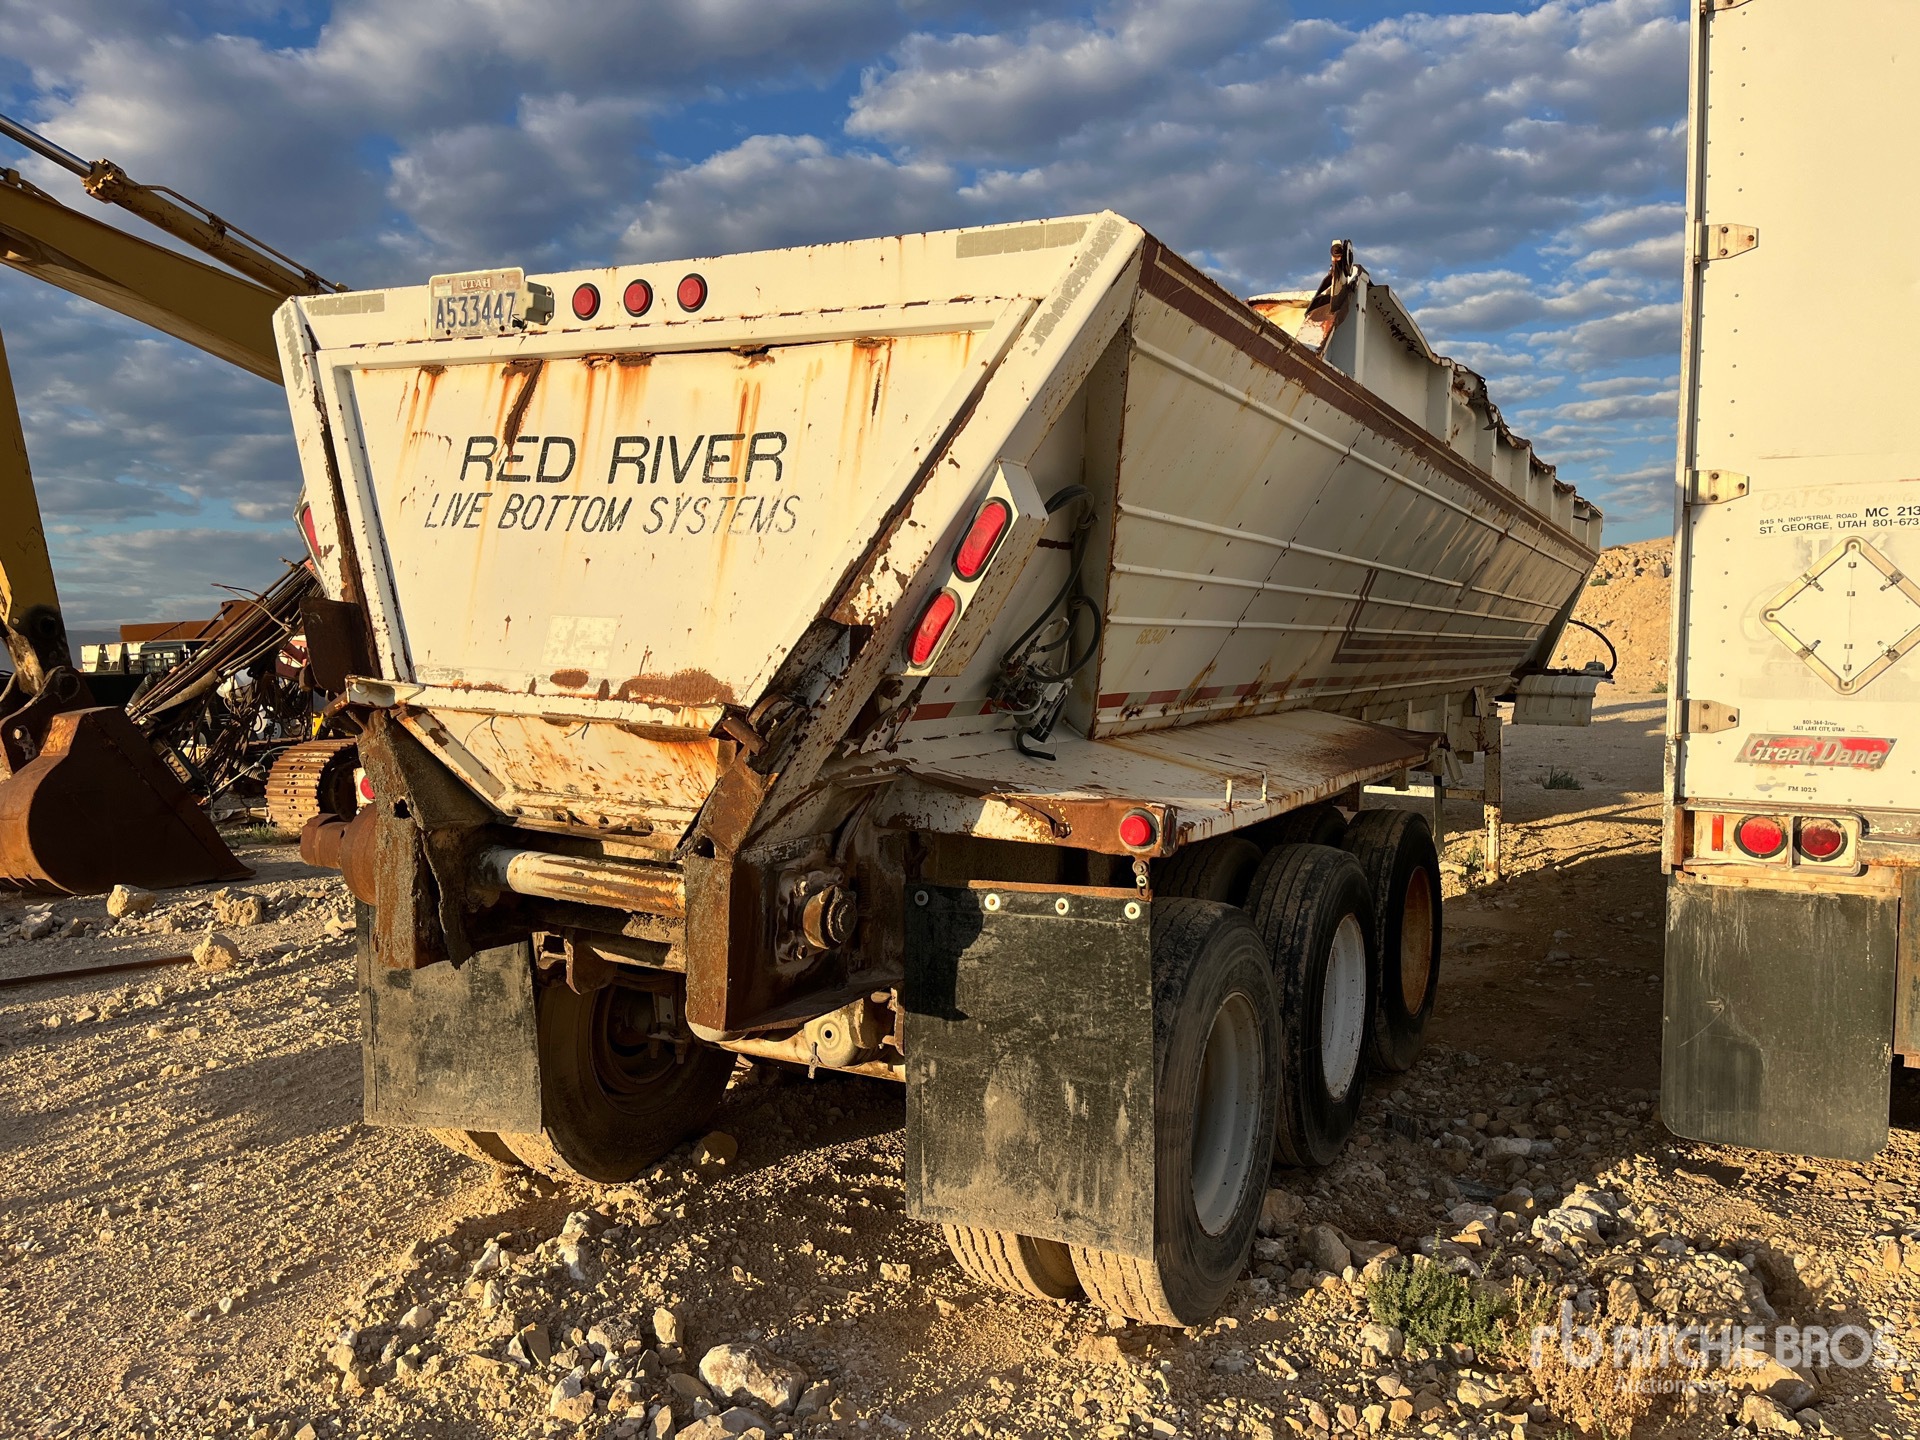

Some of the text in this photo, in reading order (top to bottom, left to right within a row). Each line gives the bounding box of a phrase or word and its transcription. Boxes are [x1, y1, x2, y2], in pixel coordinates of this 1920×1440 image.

[460, 278, 492, 290] UTAH
[436, 291, 516, 329] A533447
[460, 431, 788, 485] RED RIVER
[425, 492, 801, 535] LIVE BOTTOM SYSTEMS
[1760, 517, 1920, 534] ST. GEORGE, UTAH 801-673
[1865, 505, 1920, 518] MC 213
[1746, 735, 1883, 765] Great Dane
